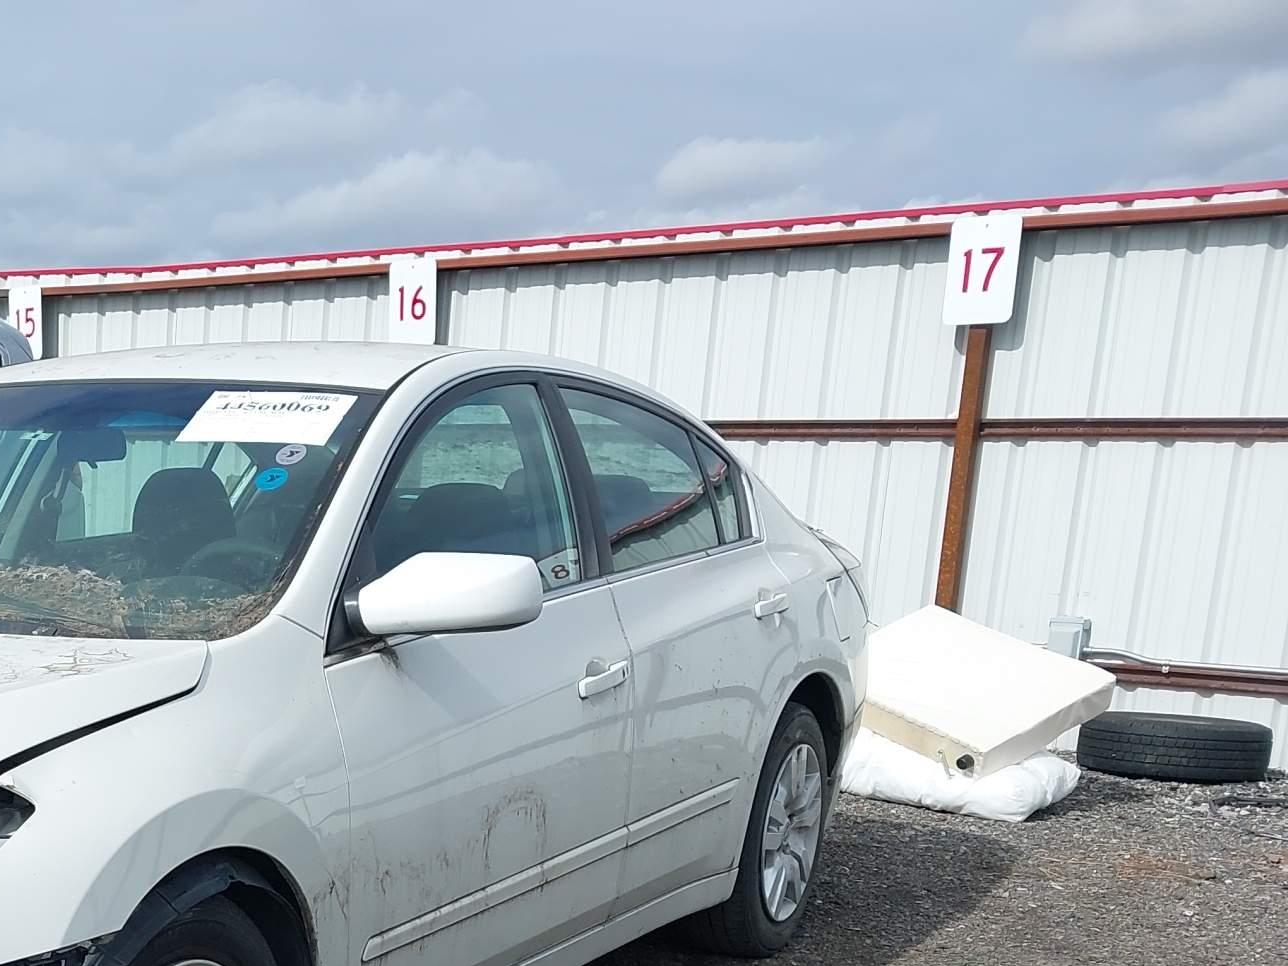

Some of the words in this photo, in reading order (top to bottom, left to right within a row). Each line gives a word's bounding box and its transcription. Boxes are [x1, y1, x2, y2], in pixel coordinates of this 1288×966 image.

[961, 246, 1006, 294] 17
[15, 306, 36, 338] 15
[398, 285, 427, 322] 16
